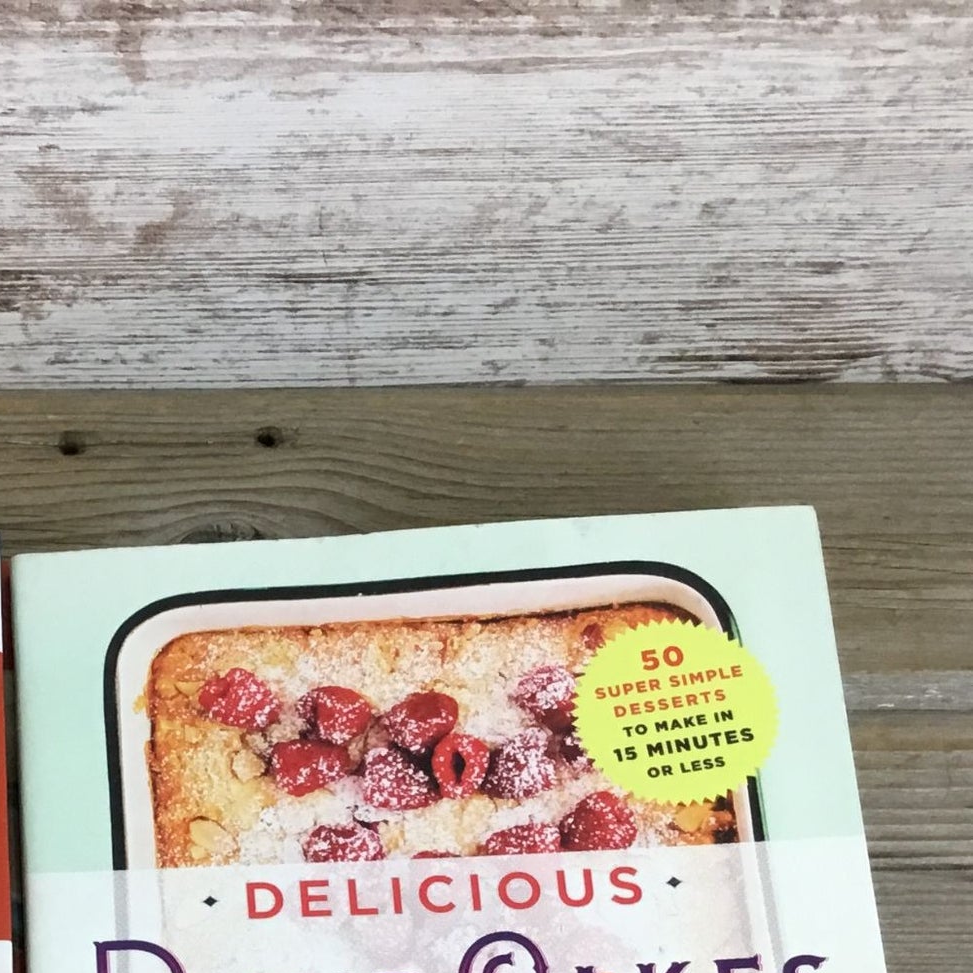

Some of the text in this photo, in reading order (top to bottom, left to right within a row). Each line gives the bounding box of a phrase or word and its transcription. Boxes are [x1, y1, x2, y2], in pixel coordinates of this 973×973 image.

[640, 645, 684, 671] 50
[594, 665, 743, 700] SUPER SIMPLE
[614, 689, 726, 718] DESSERTS
[623, 709, 734, 738] TO MAKE IN
[613, 727, 755, 763] 15 MINUTES
[647, 756, 726, 778] OR LESS
[245, 866, 645, 920] DELICIOUS
